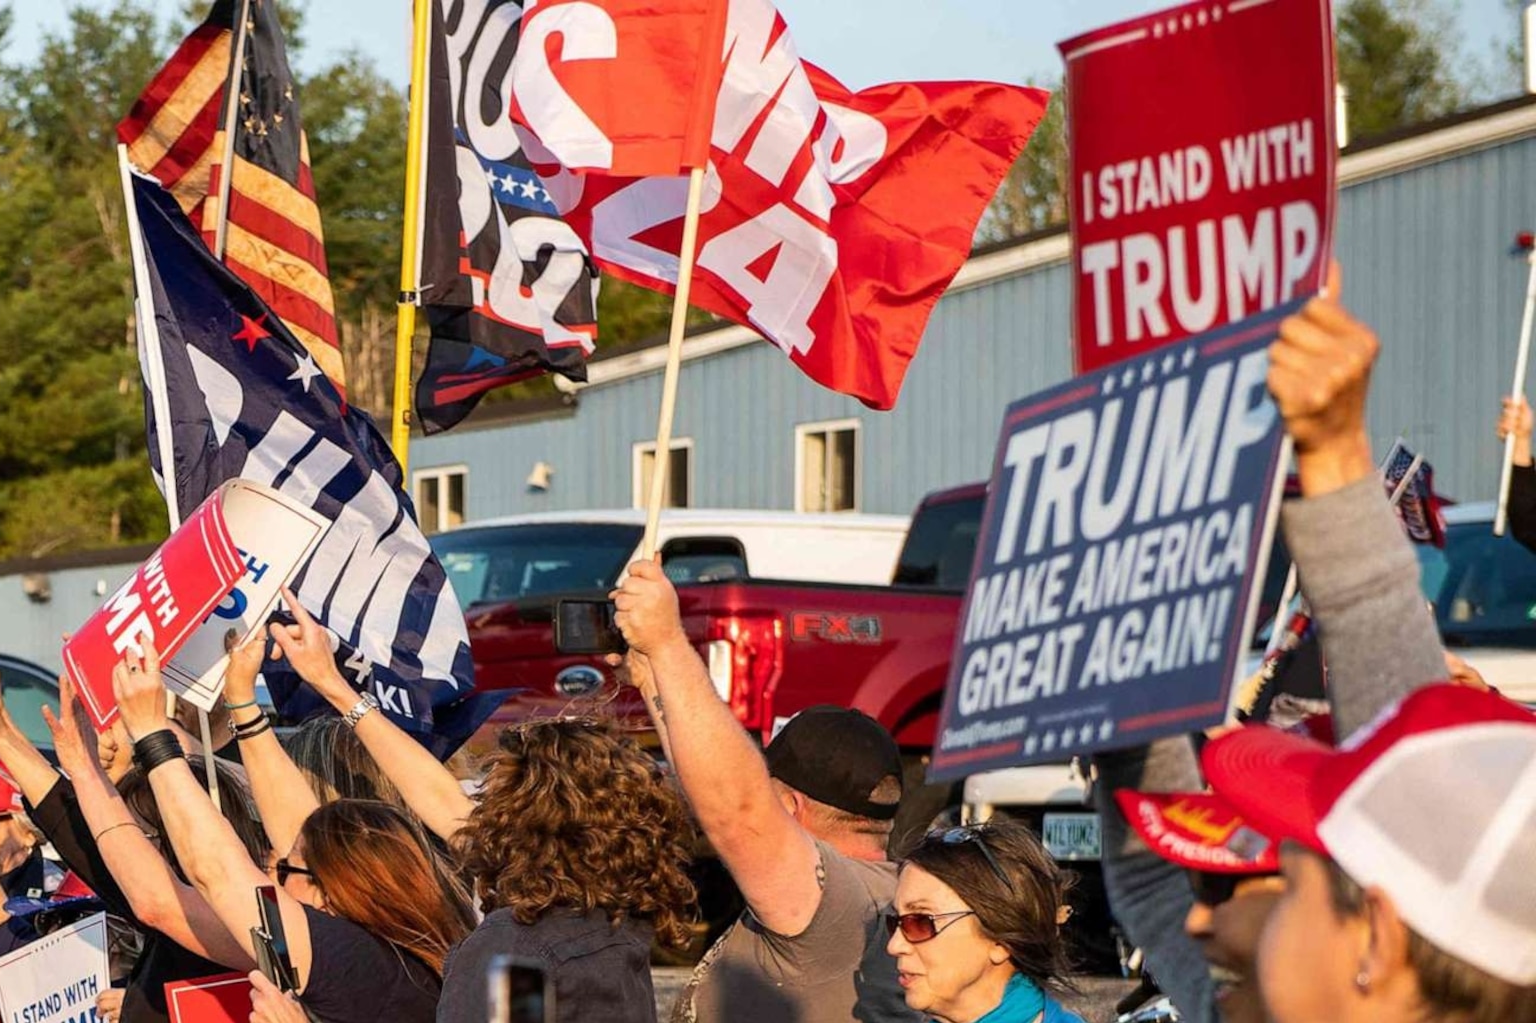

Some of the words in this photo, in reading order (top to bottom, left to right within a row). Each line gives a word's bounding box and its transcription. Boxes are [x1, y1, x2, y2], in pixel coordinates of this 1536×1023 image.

[1082, 171, 1094, 224] I
[1098, 144, 1213, 220] STAND
[1220, 117, 1314, 194] WITH
[1081, 199, 1320, 348] TRUMP
[993, 346, 1281, 567] TRUMP
[962, 552, 1076, 645] MAKE
[1065, 503, 1254, 617] AMERICA
[958, 622, 1086, 717] GREAT
[1077, 587, 1235, 690] AGAIN!
[64, 974, 98, 1007] WITH
